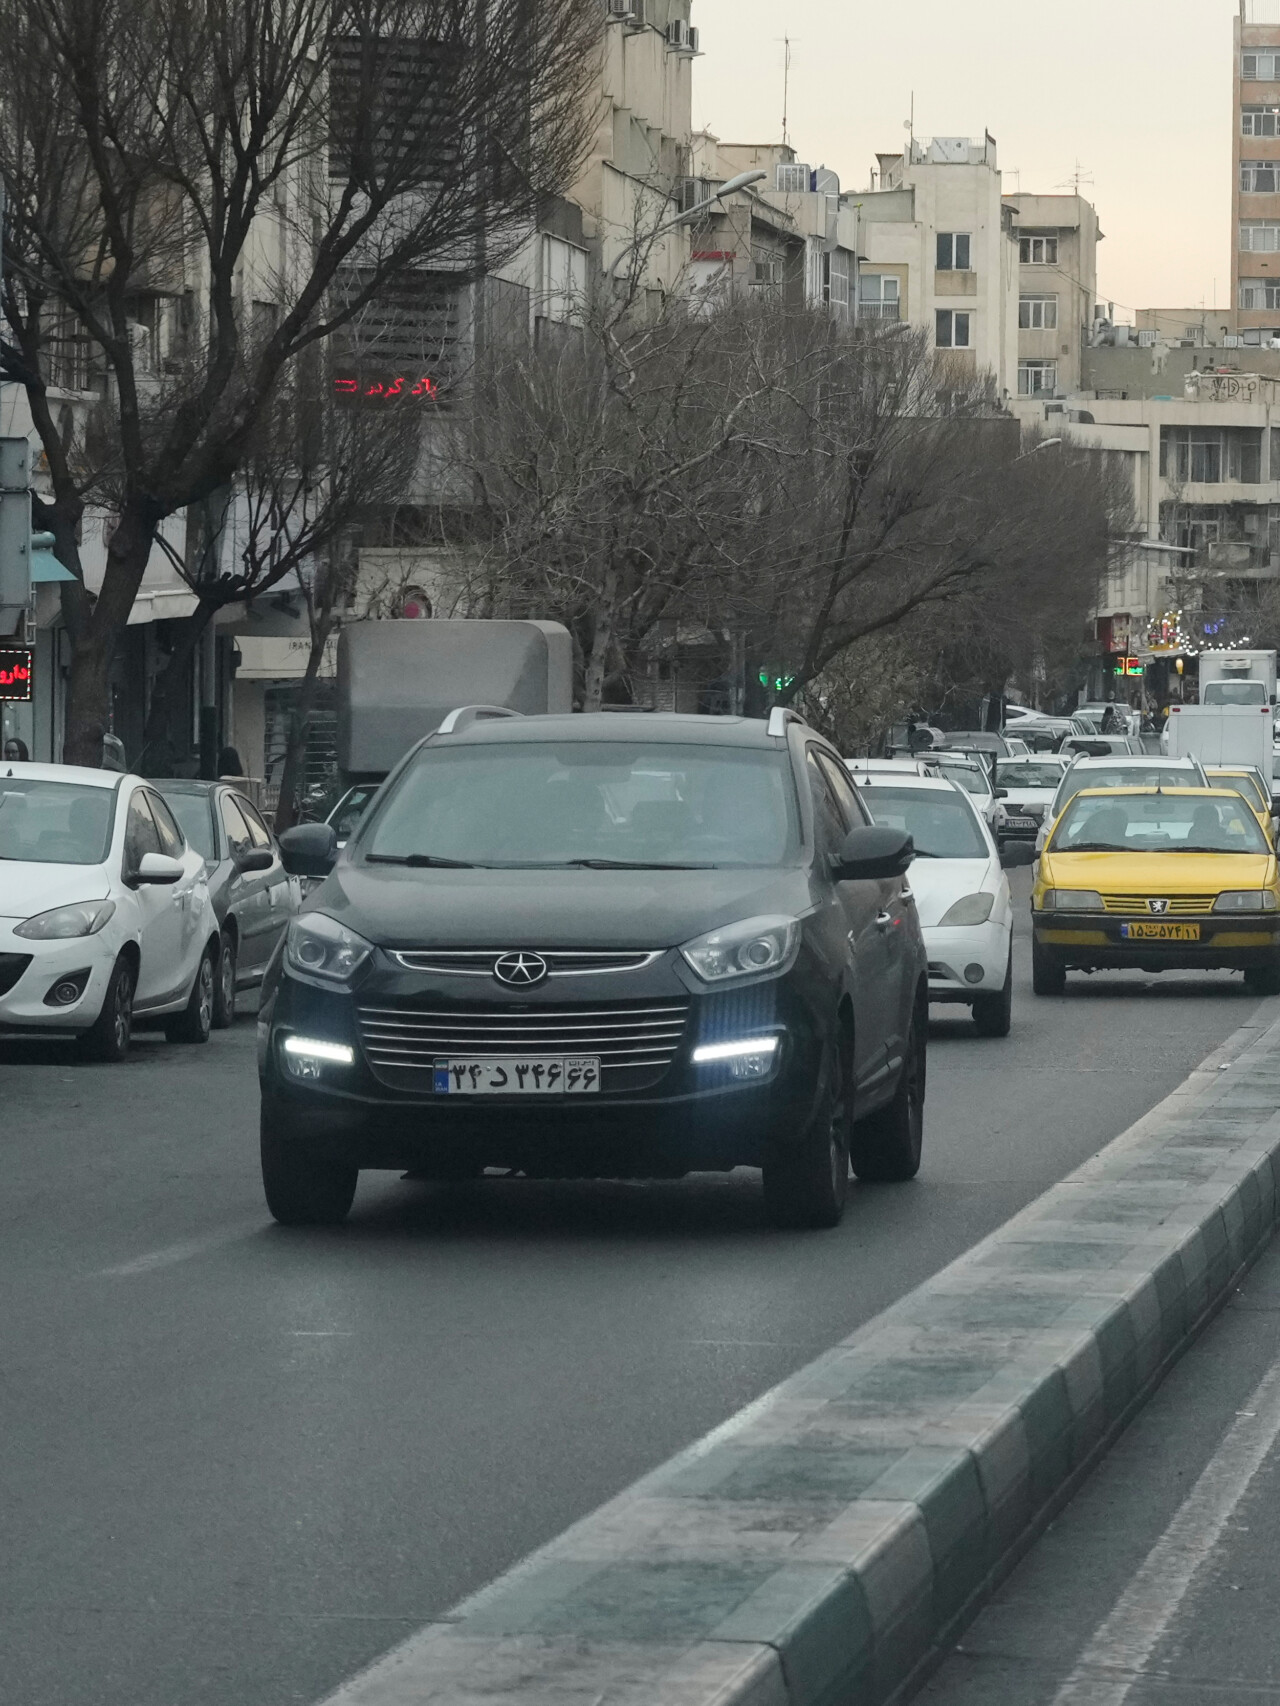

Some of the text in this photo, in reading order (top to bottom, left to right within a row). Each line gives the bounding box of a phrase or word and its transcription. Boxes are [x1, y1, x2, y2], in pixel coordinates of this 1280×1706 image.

[451, 1063, 597, 1090] ۳۴ د ۳۴۶ ۶۶
